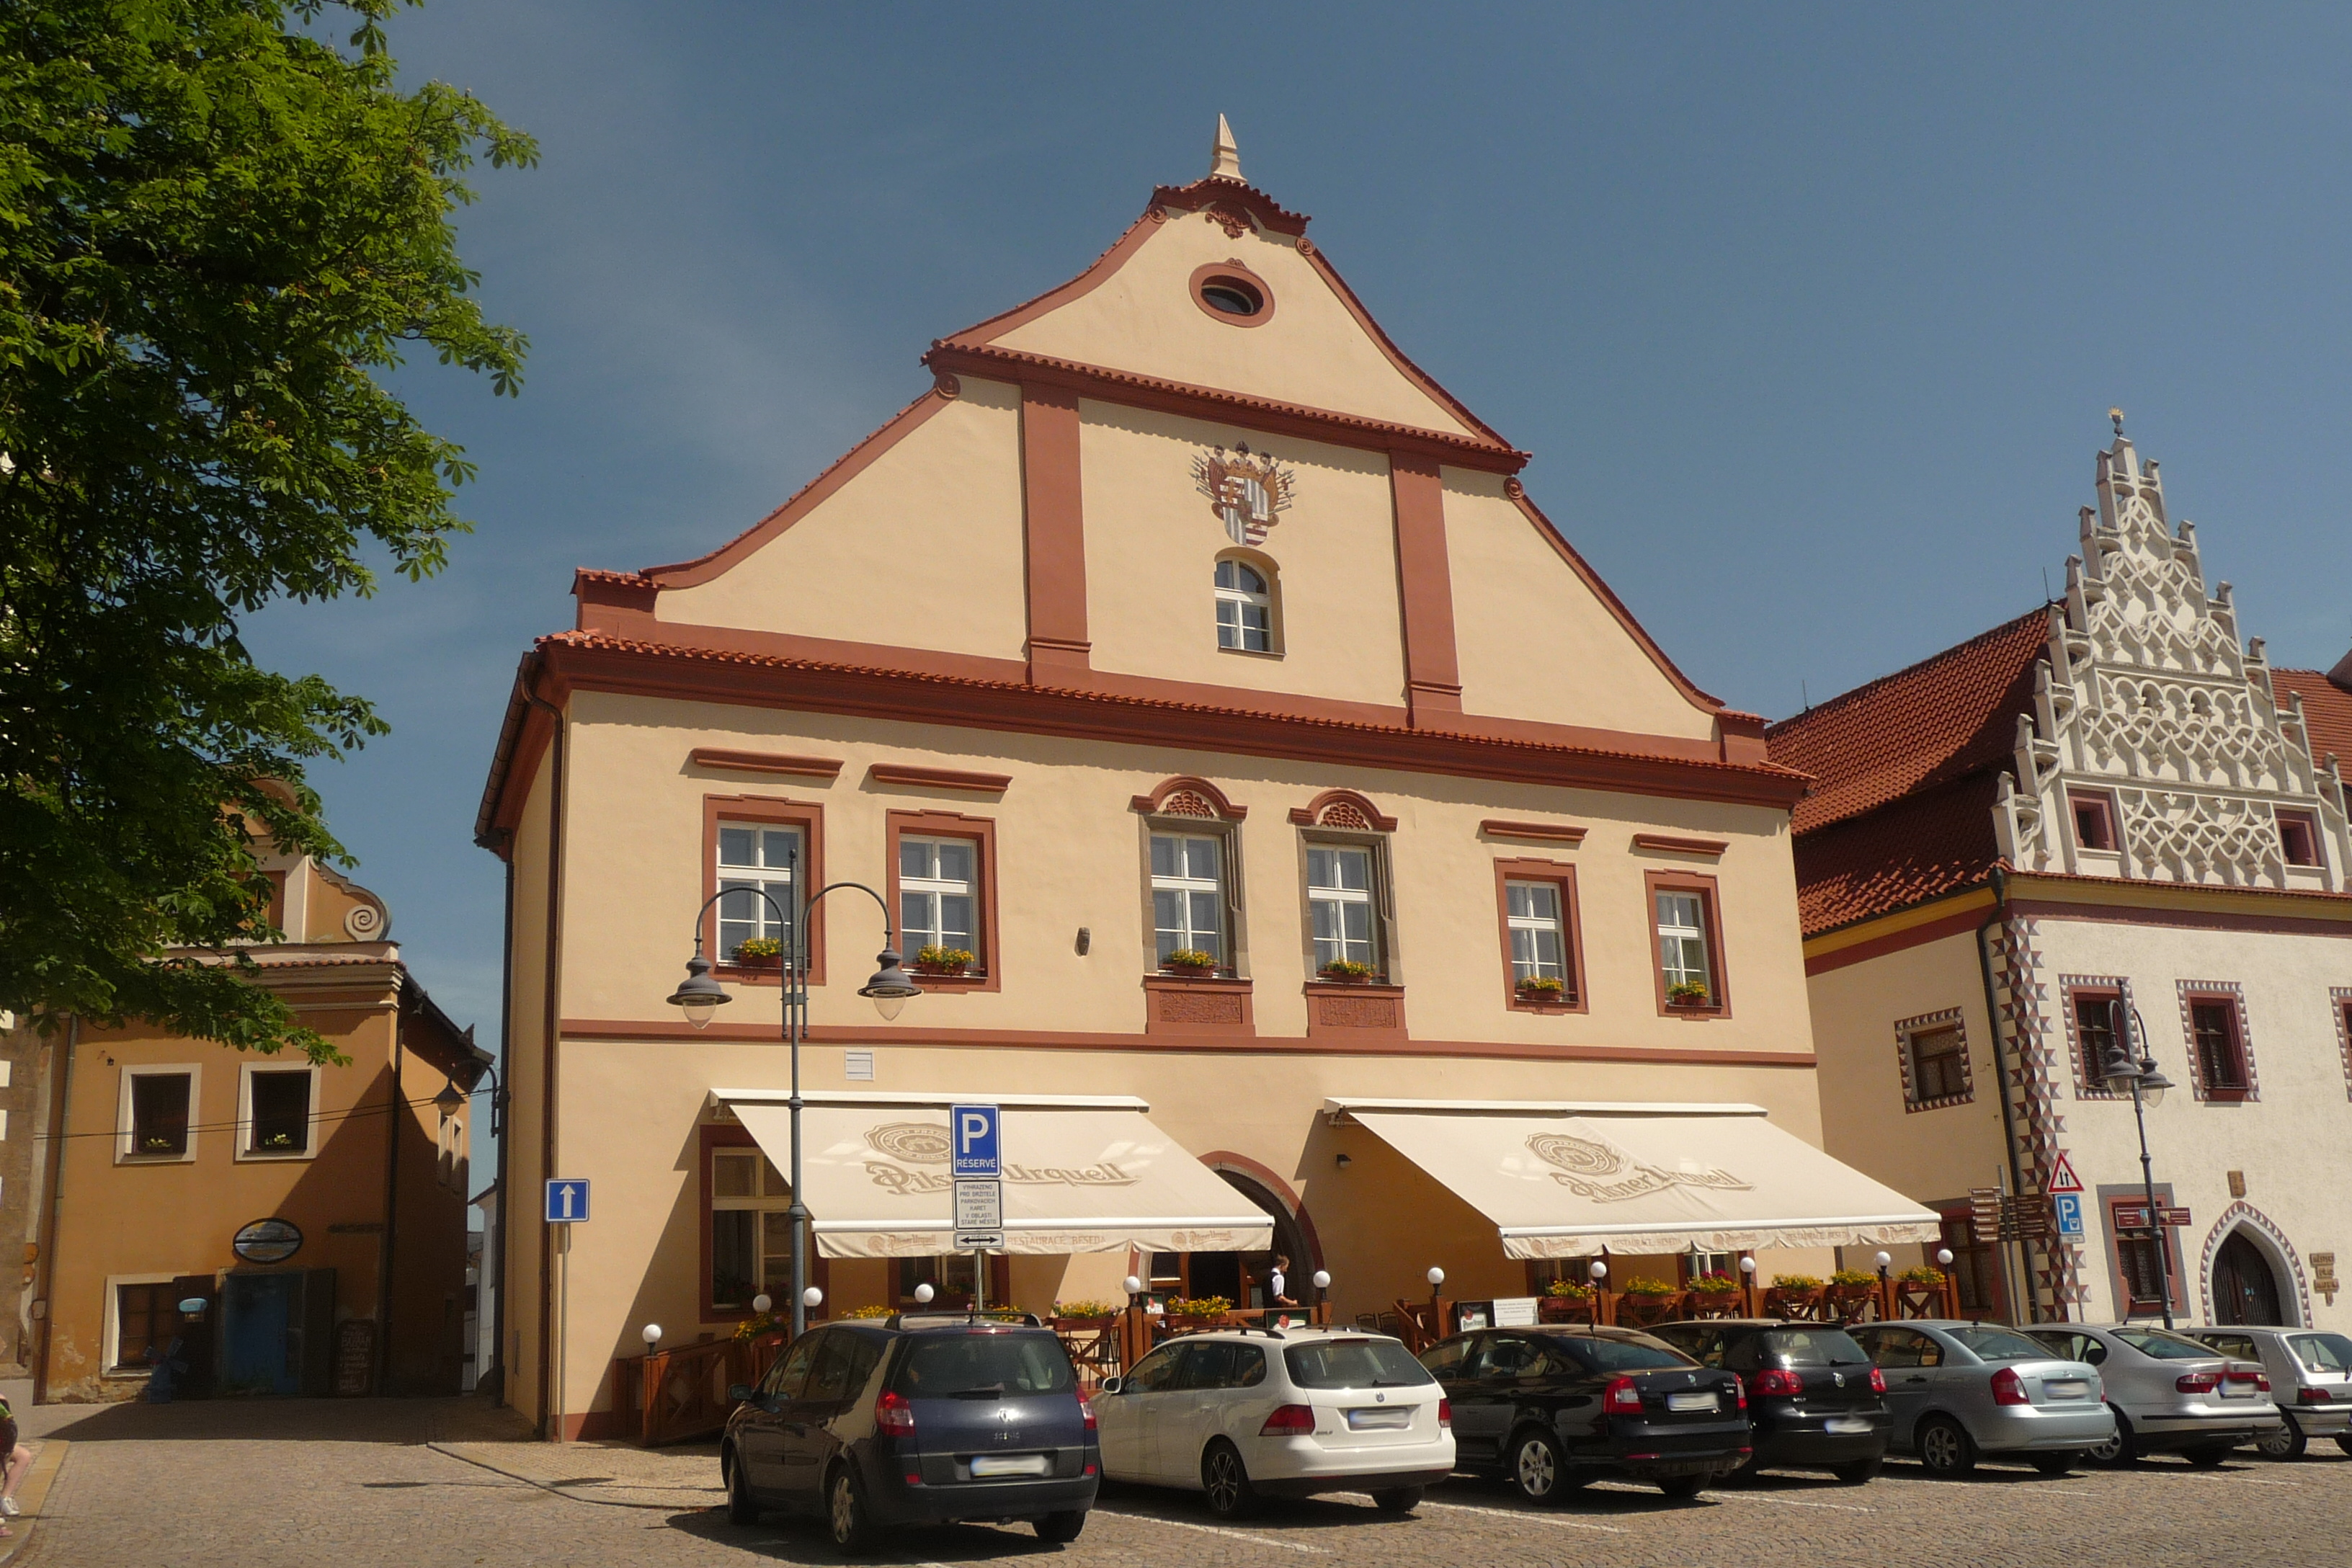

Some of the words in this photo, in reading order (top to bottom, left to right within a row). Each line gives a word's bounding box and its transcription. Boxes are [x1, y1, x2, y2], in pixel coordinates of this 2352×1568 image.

[962, 1113, 989, 1154] P
[956, 1157, 996, 1168] RÉSERVÉ
[1002, 1162, 1134, 1187] Urquell
[1549, 1172, 1655, 1203] Pilsner
[1634, 1164, 1754, 1190] Urquell
[2061, 1199, 2075, 1221] P
